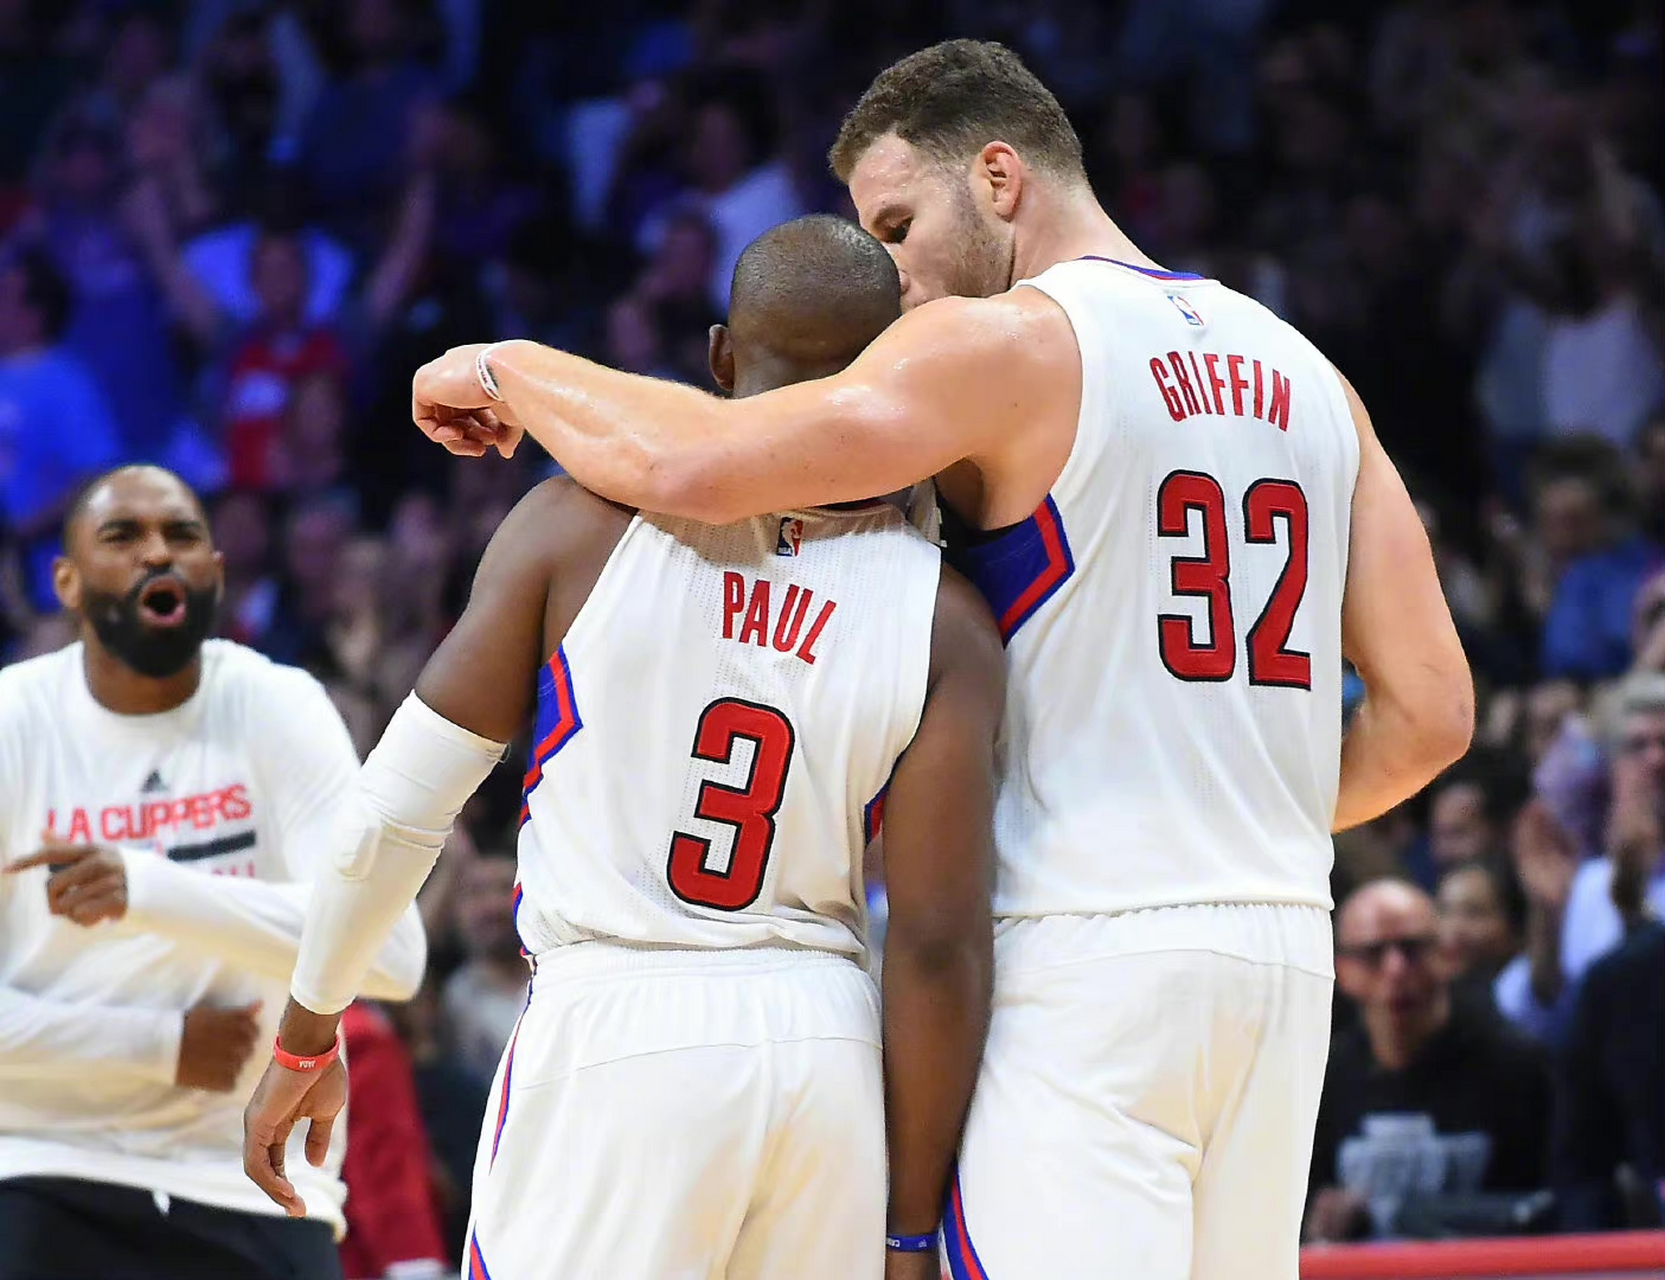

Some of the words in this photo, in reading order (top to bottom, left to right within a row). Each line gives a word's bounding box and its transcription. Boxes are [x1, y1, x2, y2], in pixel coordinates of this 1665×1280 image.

[1149, 350, 1291, 432] GRIFFIN
[722, 571, 837, 665] PAUL
[1157, 469, 1311, 692] 32
[666, 696, 795, 912] 3
